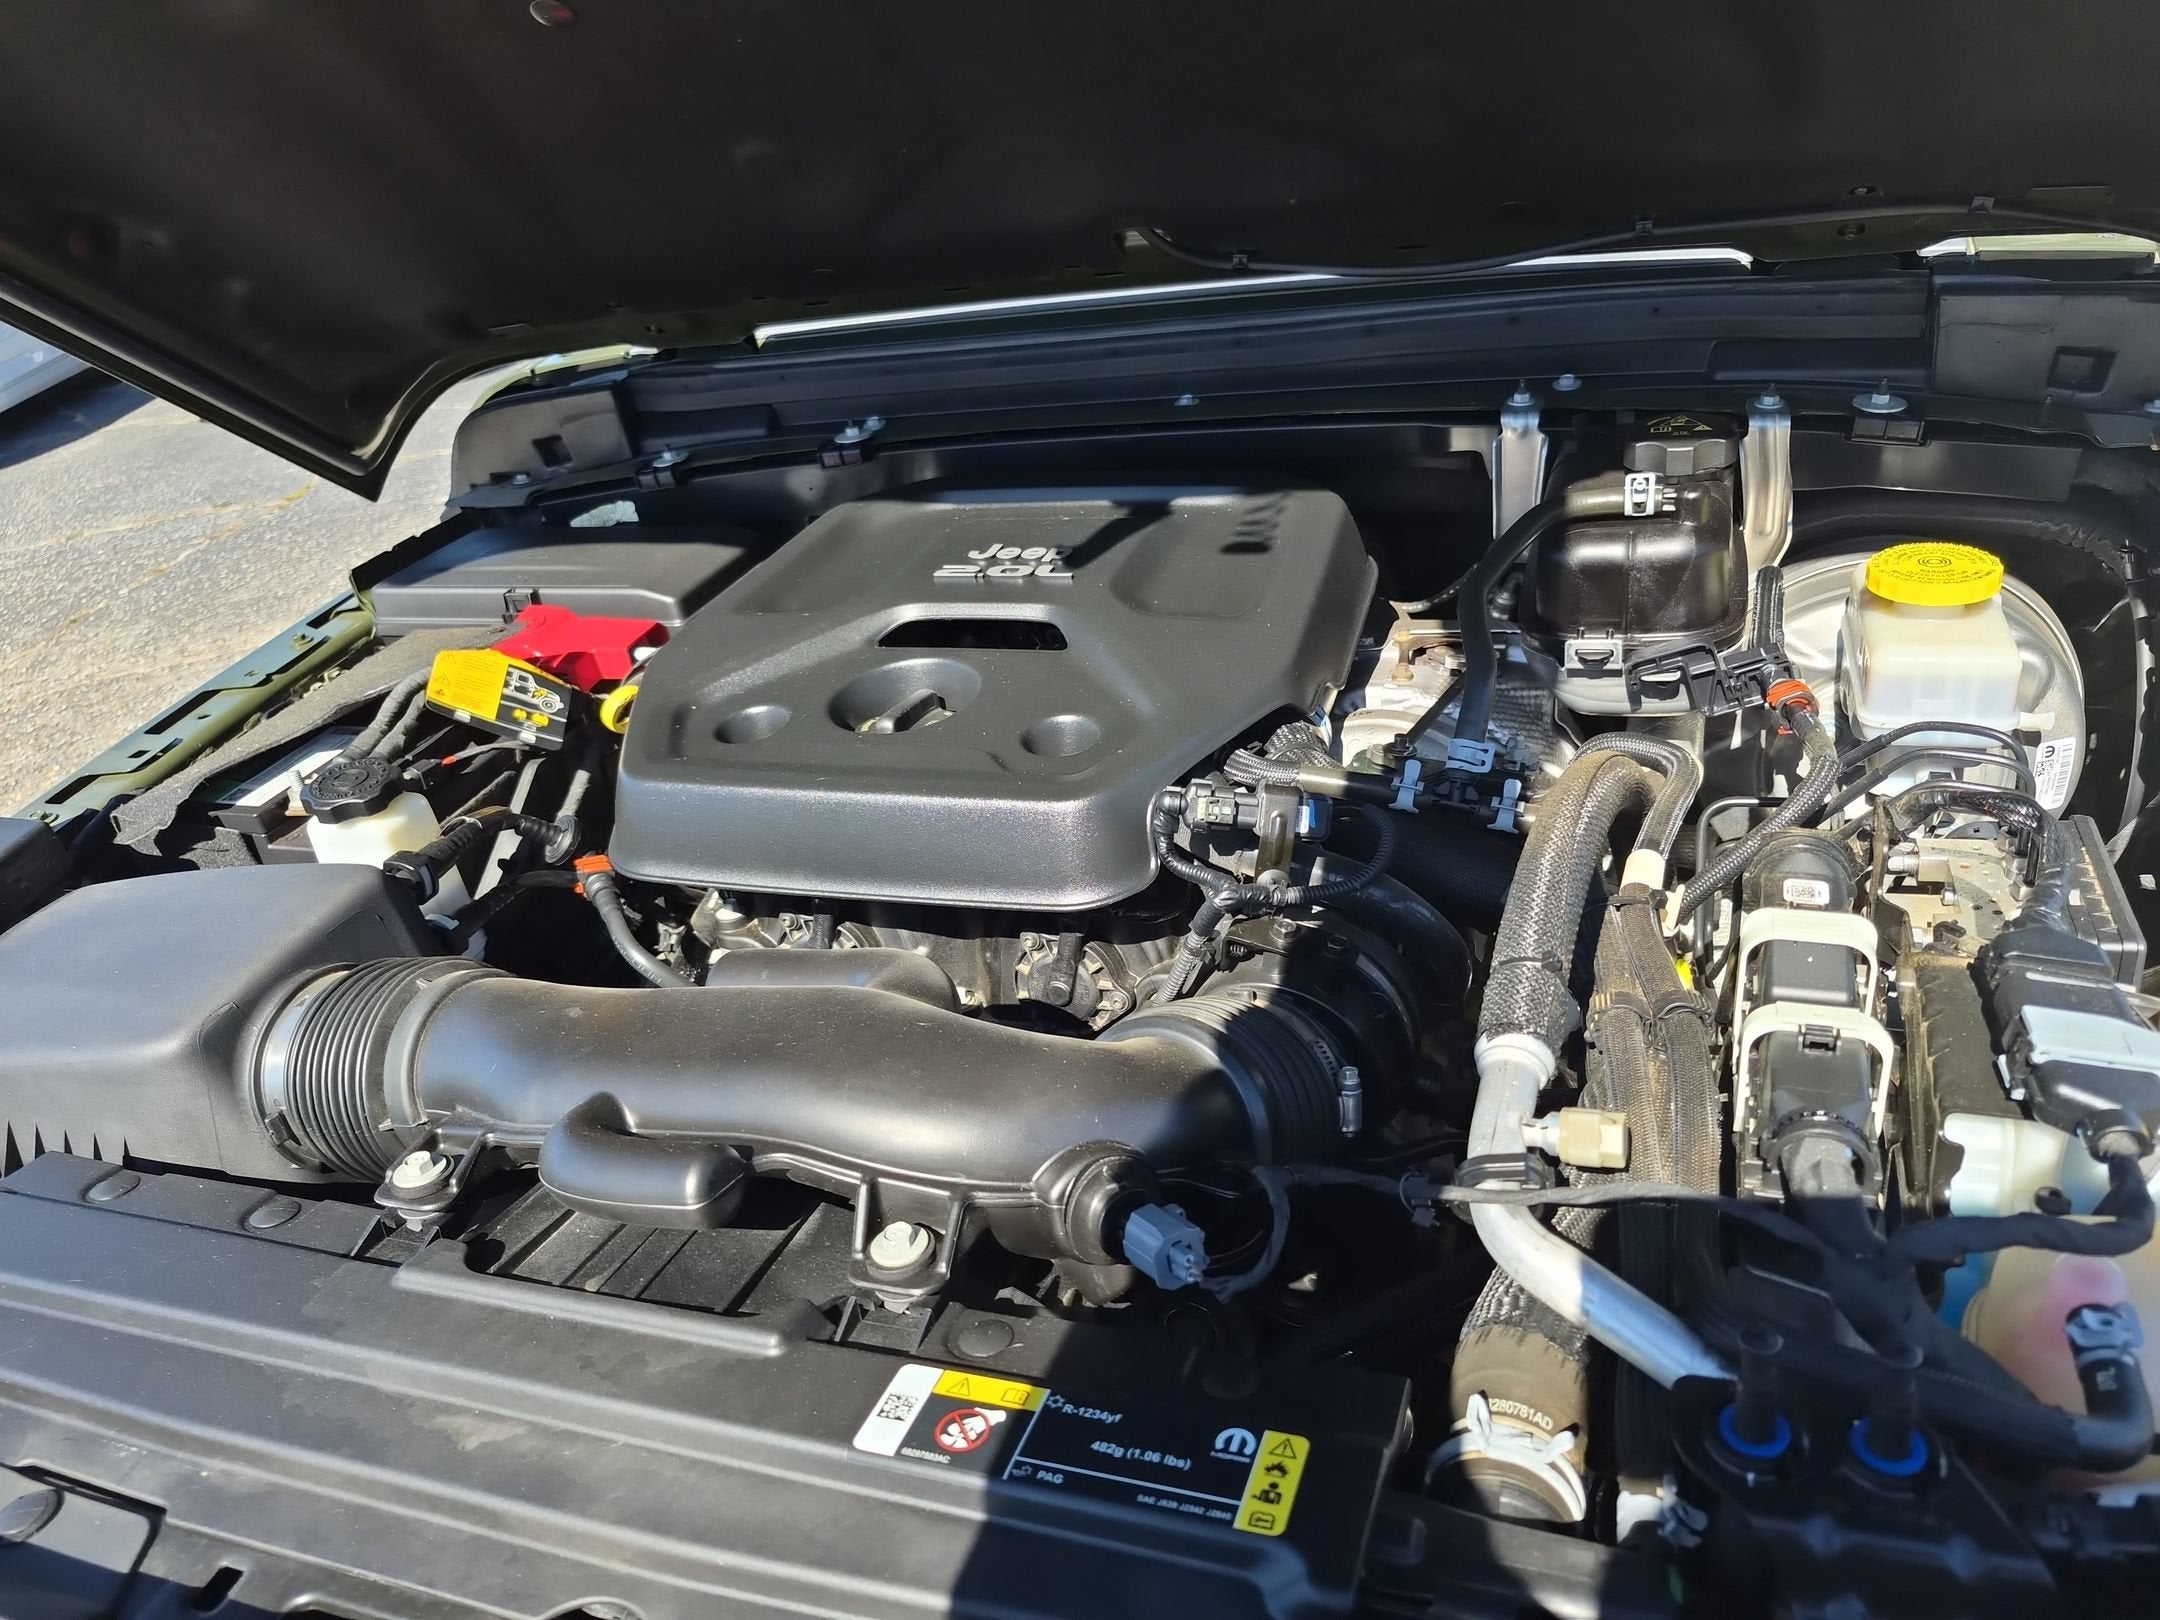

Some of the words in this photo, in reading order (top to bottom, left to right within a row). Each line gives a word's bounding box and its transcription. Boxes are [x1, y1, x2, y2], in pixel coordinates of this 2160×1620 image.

[968, 543, 1073, 562] Jeep
[933, 564, 1074, 580] 2.0L
[1062, 1403, 1124, 1424] R-1234yf
[1090, 1440, 1126, 1459] 482g
[1127, 1447, 1162, 1464] (1.06
[1163, 1453, 1193, 1471] lbs)
[1036, 1469, 1065, 1484] PAG
[1136, 1493, 1157, 1505] SAE
